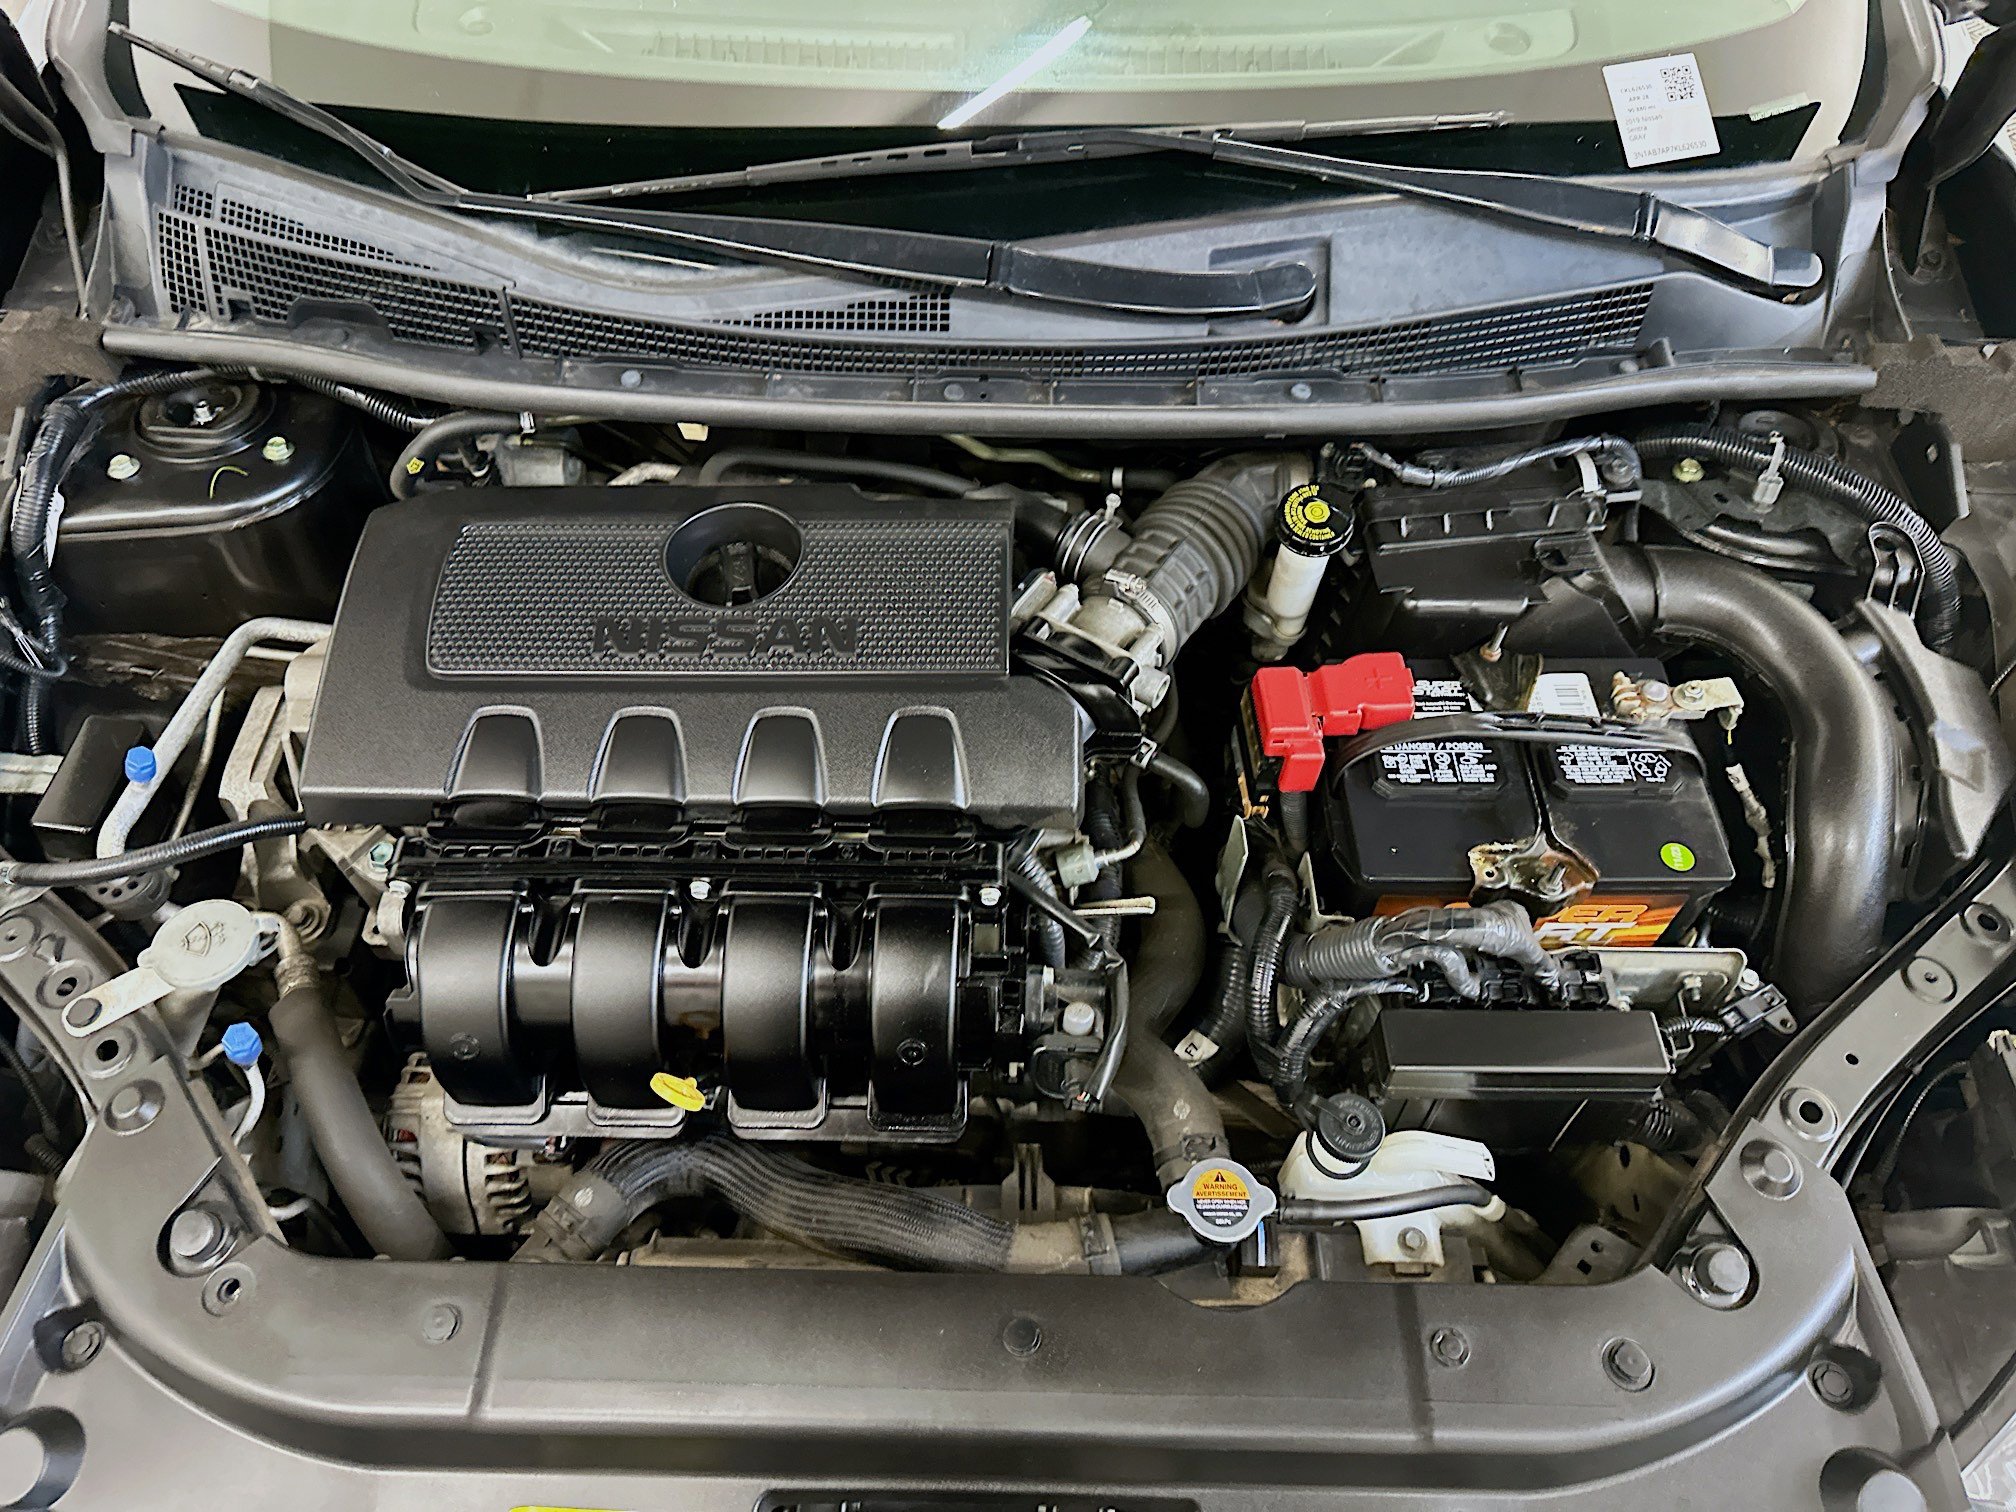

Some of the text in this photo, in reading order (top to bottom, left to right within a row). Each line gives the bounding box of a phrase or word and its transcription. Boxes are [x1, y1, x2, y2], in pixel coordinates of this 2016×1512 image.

[1641, 114, 1663, 122] Nissan
[1626, 126, 1648, 134] Sentra
[593, 617, 858, 656] NISSAN
[1446, 742, 1484, 750] POISON
[1184, 1042, 1198, 1057] F7
